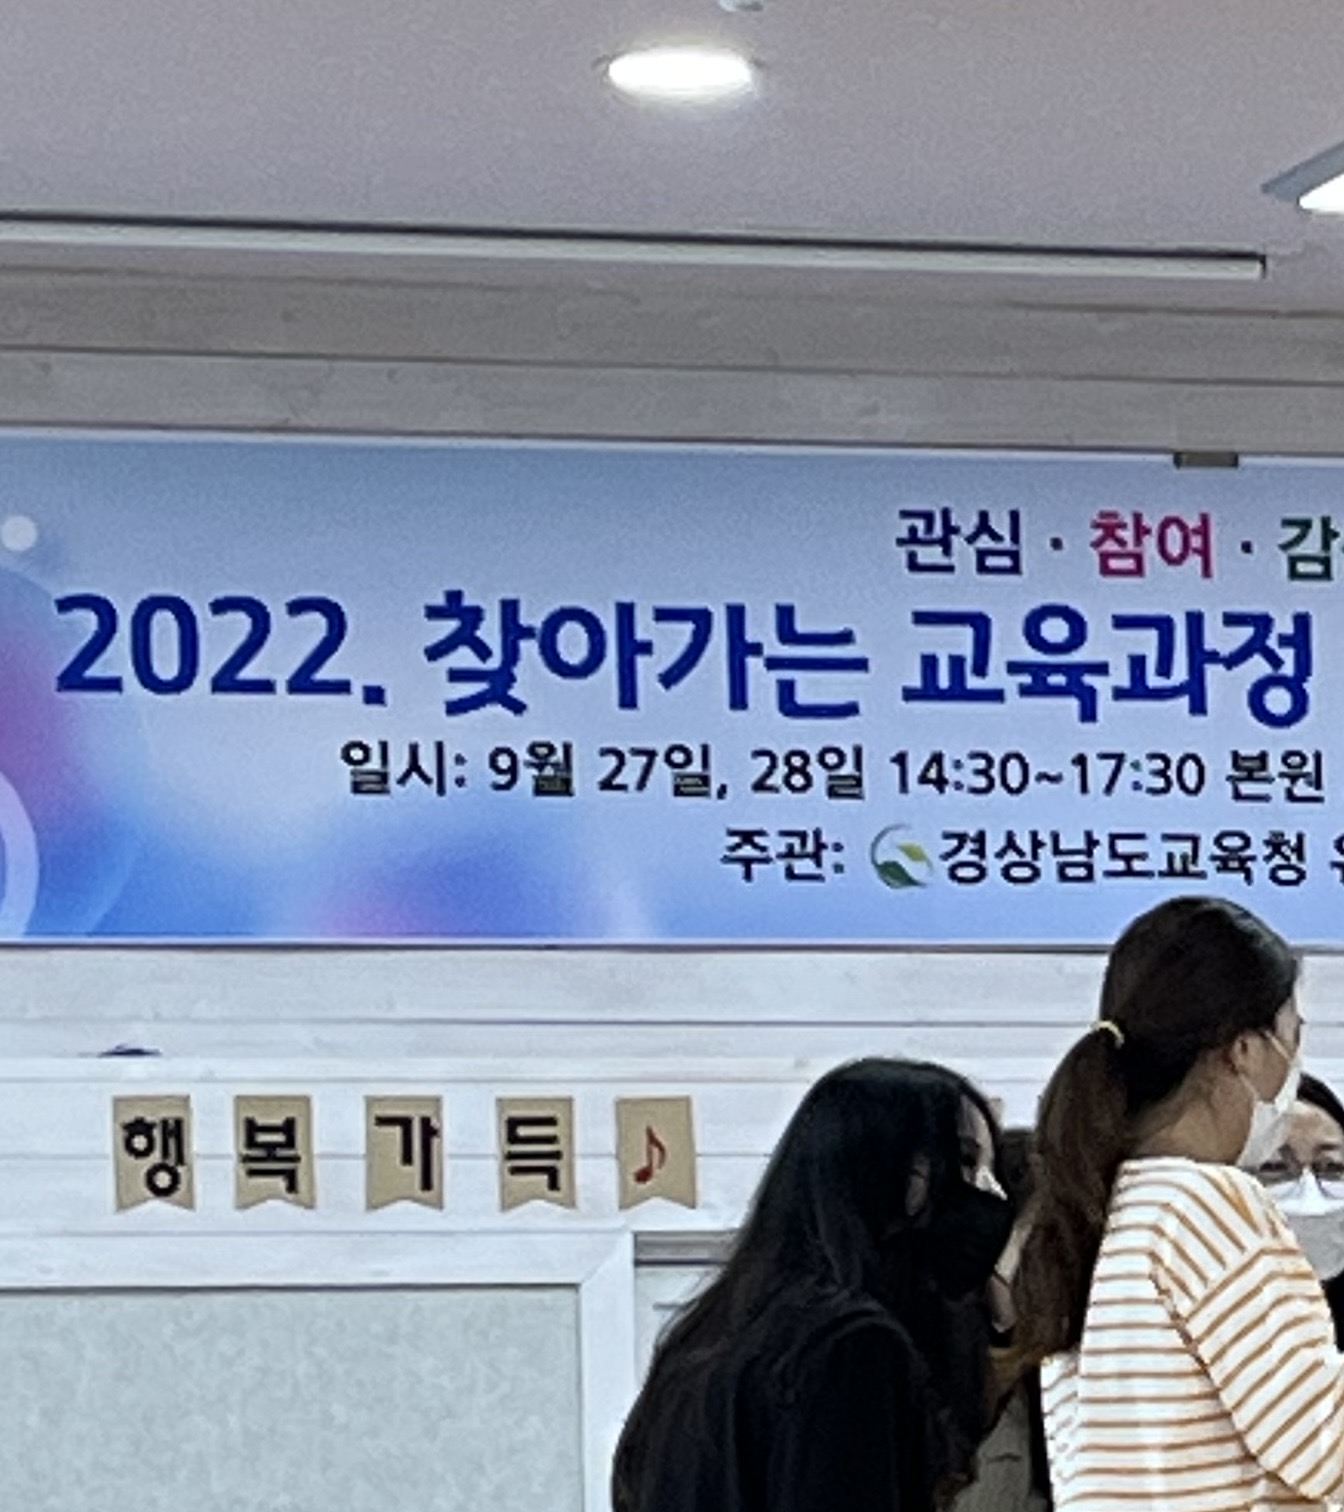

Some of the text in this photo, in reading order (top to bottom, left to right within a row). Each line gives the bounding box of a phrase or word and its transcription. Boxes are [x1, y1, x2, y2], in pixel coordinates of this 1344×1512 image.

[896, 507, 1023, 576] 관심
[1090, 511, 1213, 579] 참여
[54, 593, 388, 707] 2022.
[423, 589, 869, 719] 찾아가는
[902, 604, 1313, 729] 교육과정
[341, 740, 468, 797] 일시:
[489, 740, 575, 798] 9월
[598, 743, 728, 801] 27일,
[751, 744, 866, 801] 28일
[890, 750, 1206, 797] 14:30~17:30
[1225, 749, 1326, 803] 본원
[720, 826, 845, 884] 주관:
[938, 828, 1307, 888] 경상남도교육청
